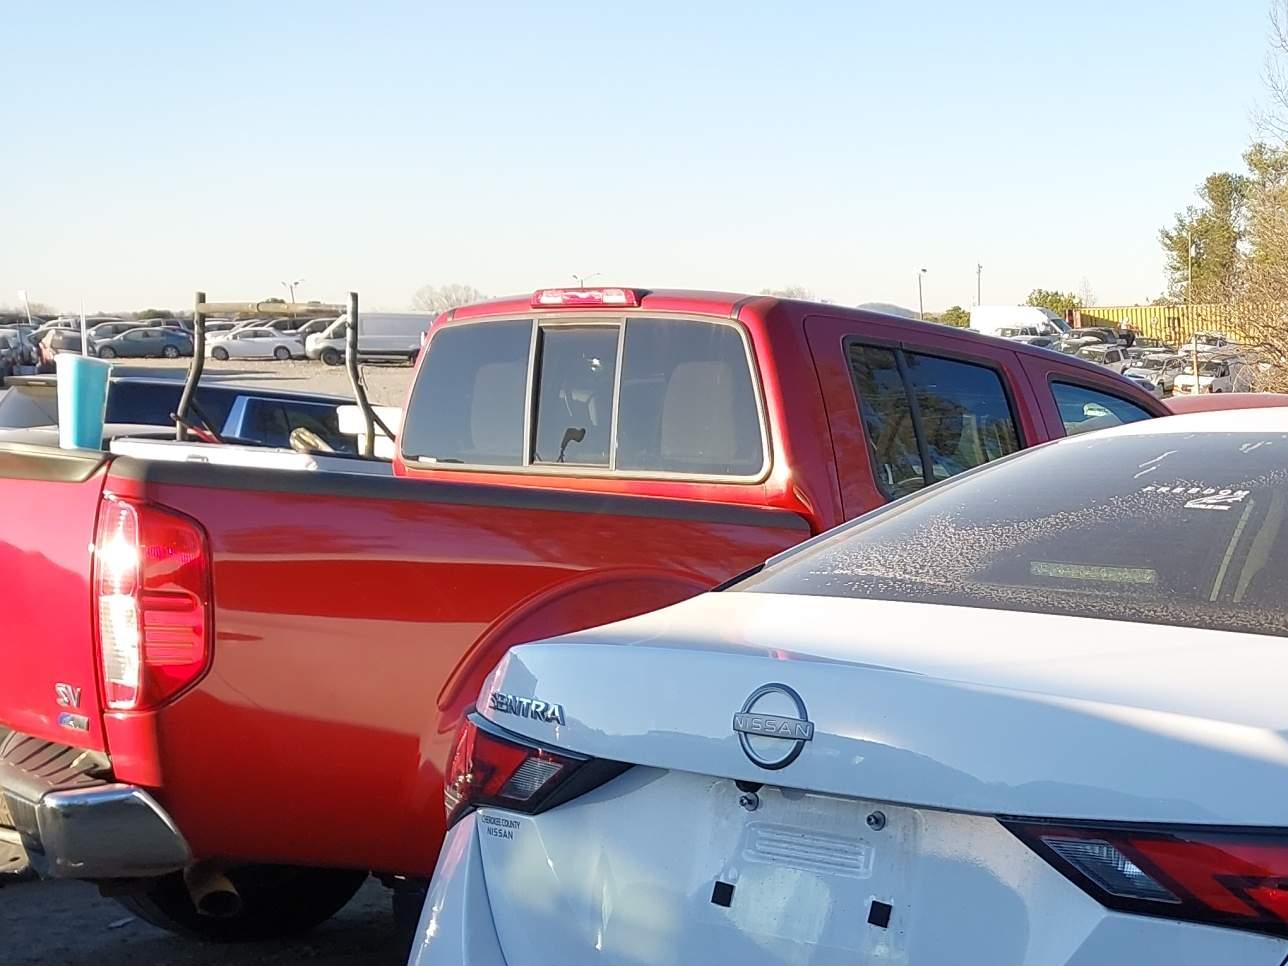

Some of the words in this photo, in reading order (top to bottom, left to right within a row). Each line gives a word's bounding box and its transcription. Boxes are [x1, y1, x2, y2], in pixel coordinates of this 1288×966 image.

[55, 682, 81, 708] SV
[489, 692, 566, 726] SENTRA
[735, 716, 811, 737] NISSAN
[487, 826, 514, 840] NISSAN
